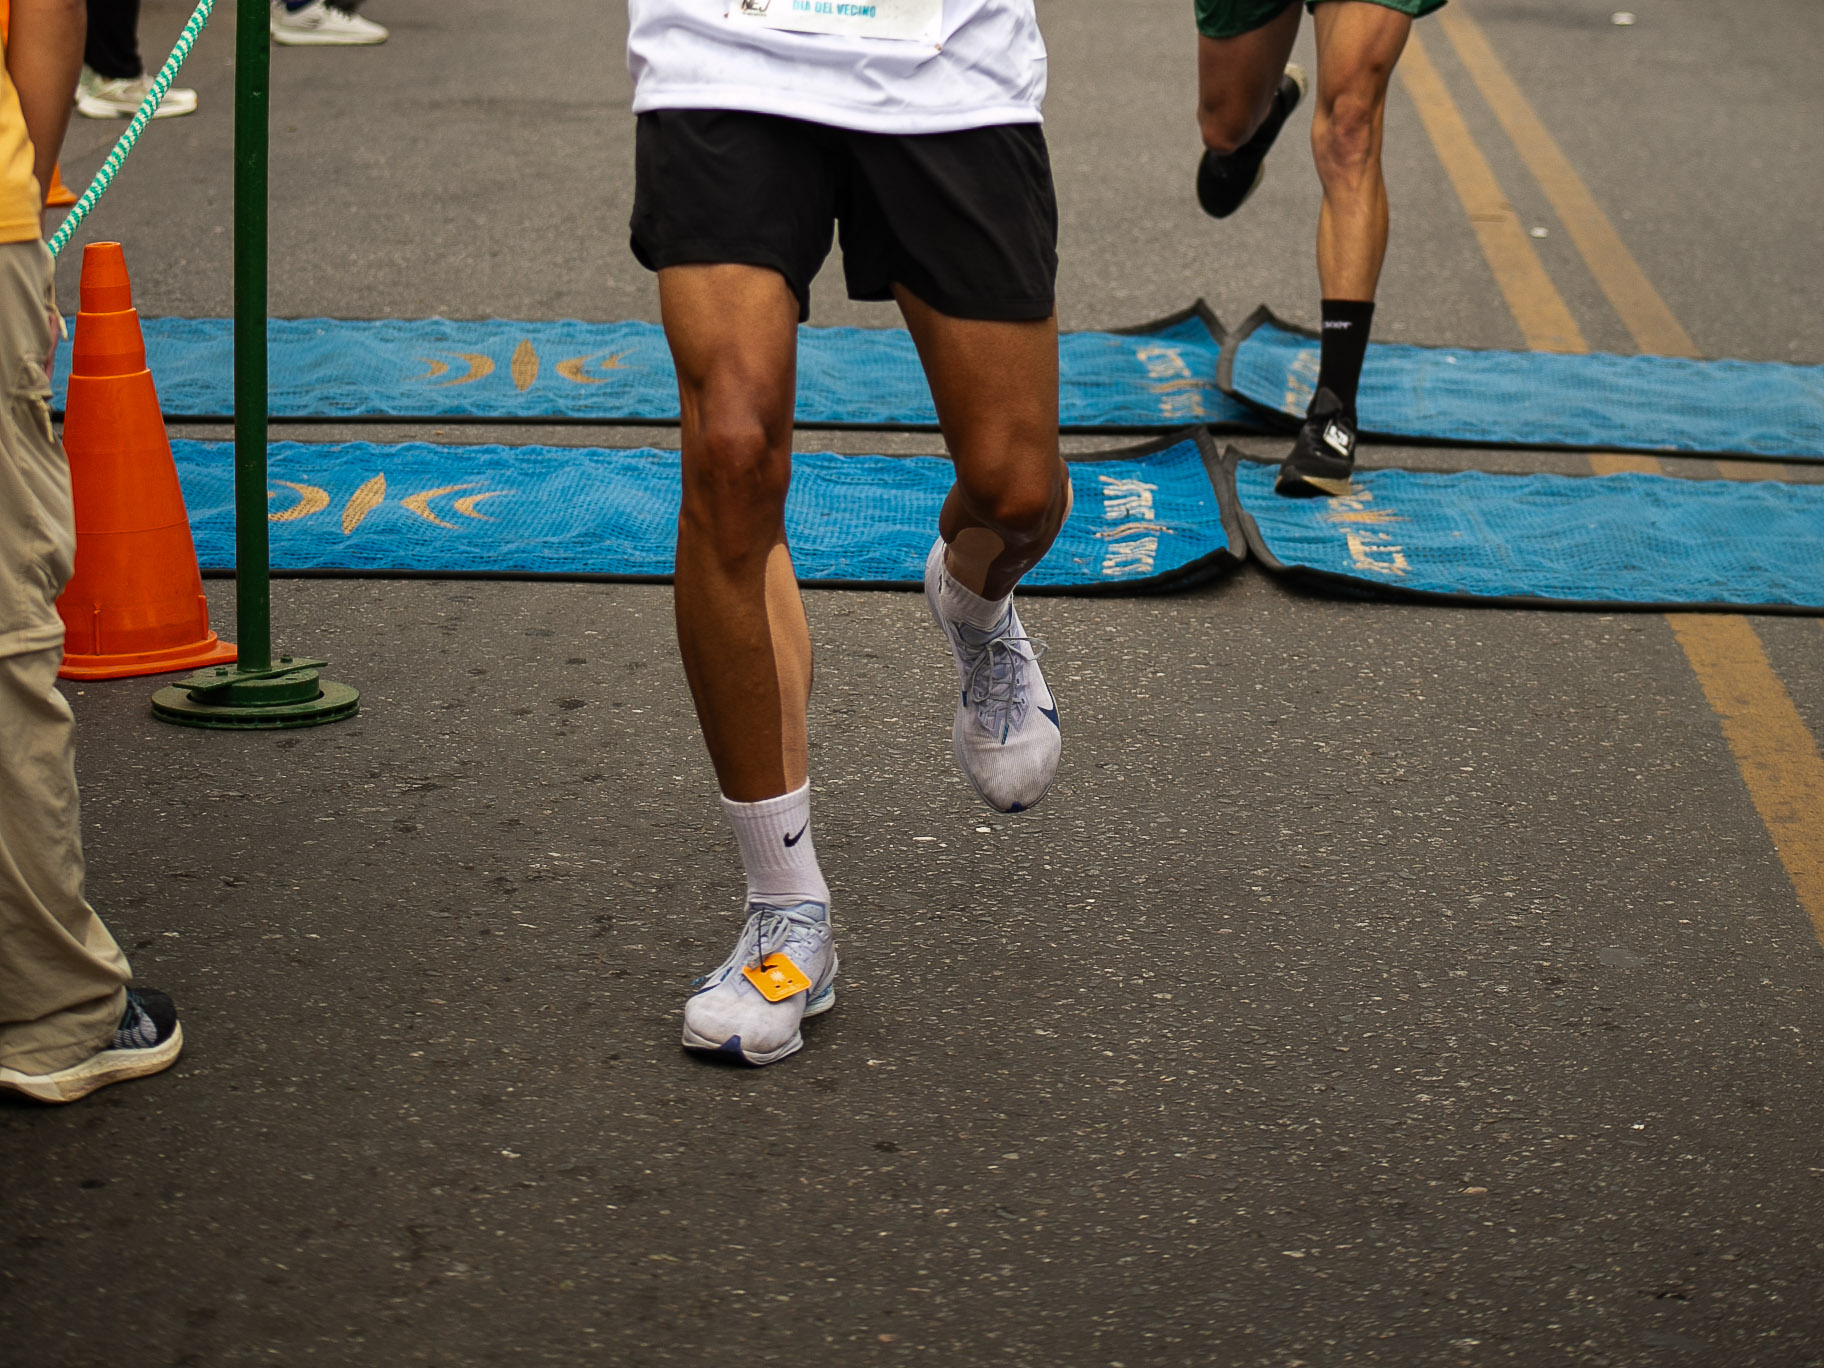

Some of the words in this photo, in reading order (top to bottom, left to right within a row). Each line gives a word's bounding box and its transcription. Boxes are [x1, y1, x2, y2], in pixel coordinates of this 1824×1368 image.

[792, 0, 811, 11] DIA
[814, 1, 833, 14] DEL
[836, 3, 877, 18] VECINO
